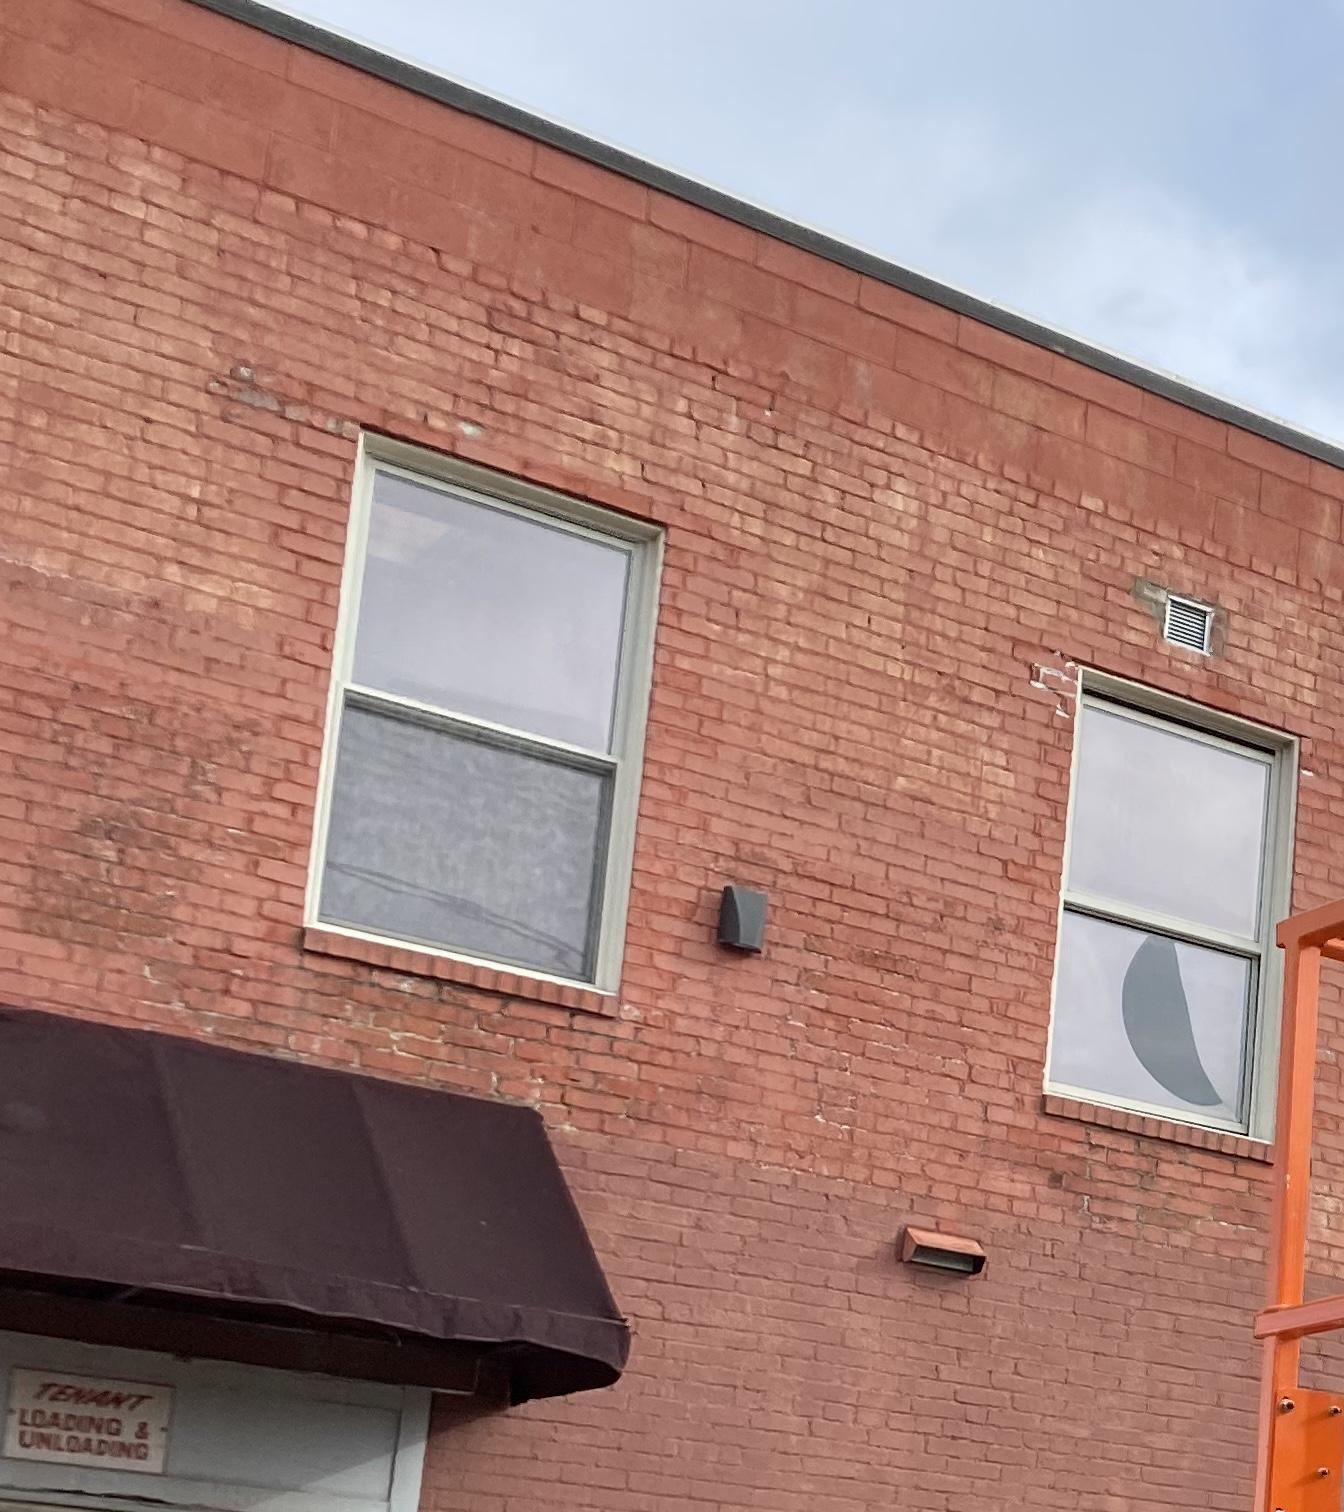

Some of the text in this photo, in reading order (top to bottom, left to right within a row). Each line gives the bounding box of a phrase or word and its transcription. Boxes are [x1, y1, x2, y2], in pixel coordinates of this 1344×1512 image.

[33, 1383, 153, 1411] TENANT
[19, 1408, 149, 1439] LOADING &
[19, 1430, 149, 1460] UNLOADING
